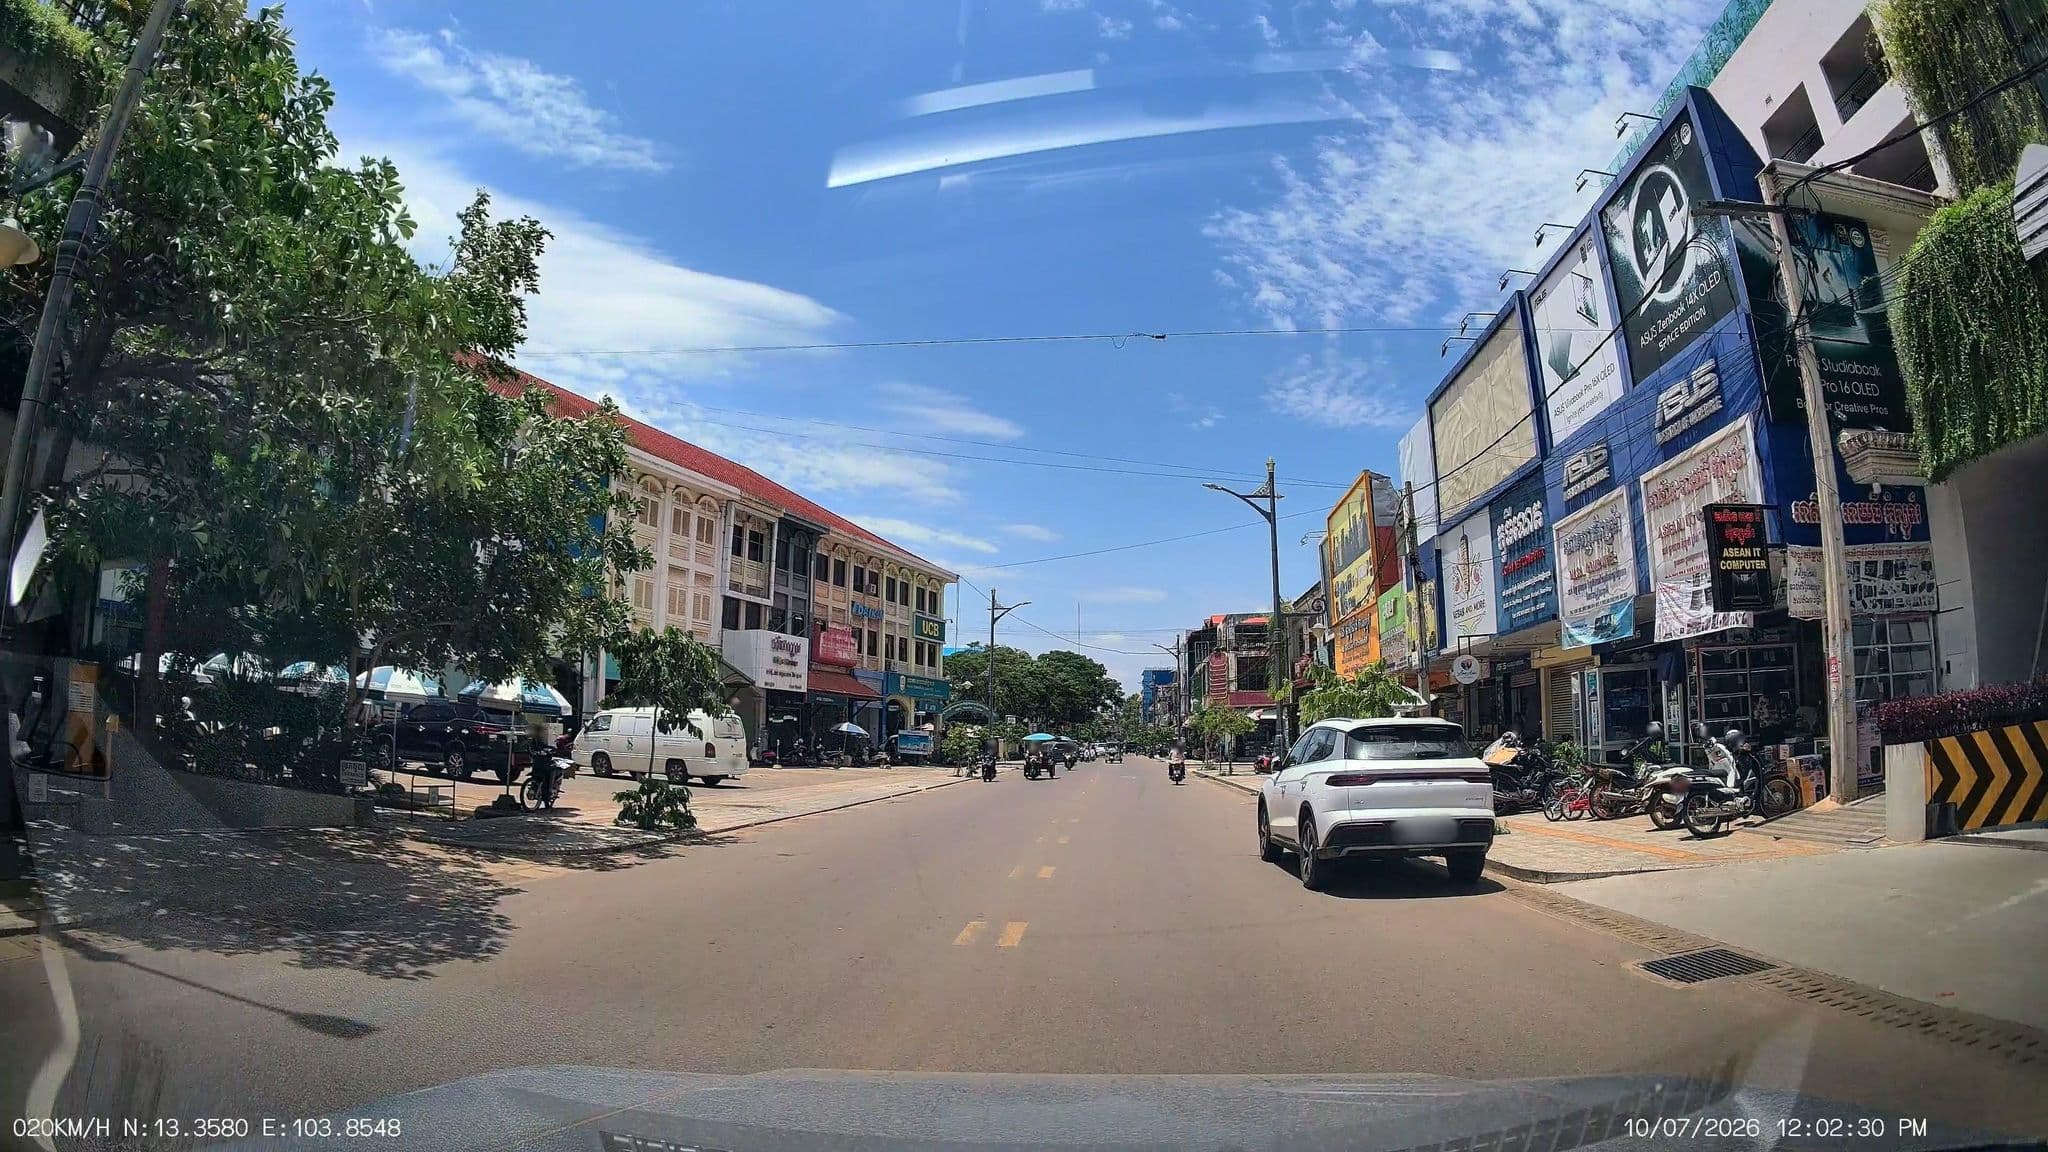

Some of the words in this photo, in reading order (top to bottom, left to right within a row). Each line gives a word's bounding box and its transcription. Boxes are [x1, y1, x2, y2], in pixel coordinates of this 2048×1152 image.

[1640, 328, 1657, 349] ASUS
[1657, 306, 1686, 334] Zenbook
[1685, 290, 1700, 312] 14X
[1699, 270, 1722, 298] OLED
[1658, 327, 1680, 352] SPACE
[1680, 310, 1707, 334] EDITION
[1599, 362, 1616, 383] OLED
[1821, 358, 1882, 377] Studiobook
[1655, 359, 1719, 429] ASUS
[1838, 380, 1850, 394] 16
[1851, 381, 1880, 397] OLED
[1834, 401, 1869, 414] Creative
[1870, 403, 1889, 415] Pros
[1722, 547, 1751, 558] ASEAN
[1753, 547, 1761, 557] IT
[1720, 559, 1767, 570] COMPUTER
[1452, 606, 1465, 619] KEBAB
[1473, 599, 1486, 612] MORE
[922, 619, 940, 637] UCB
